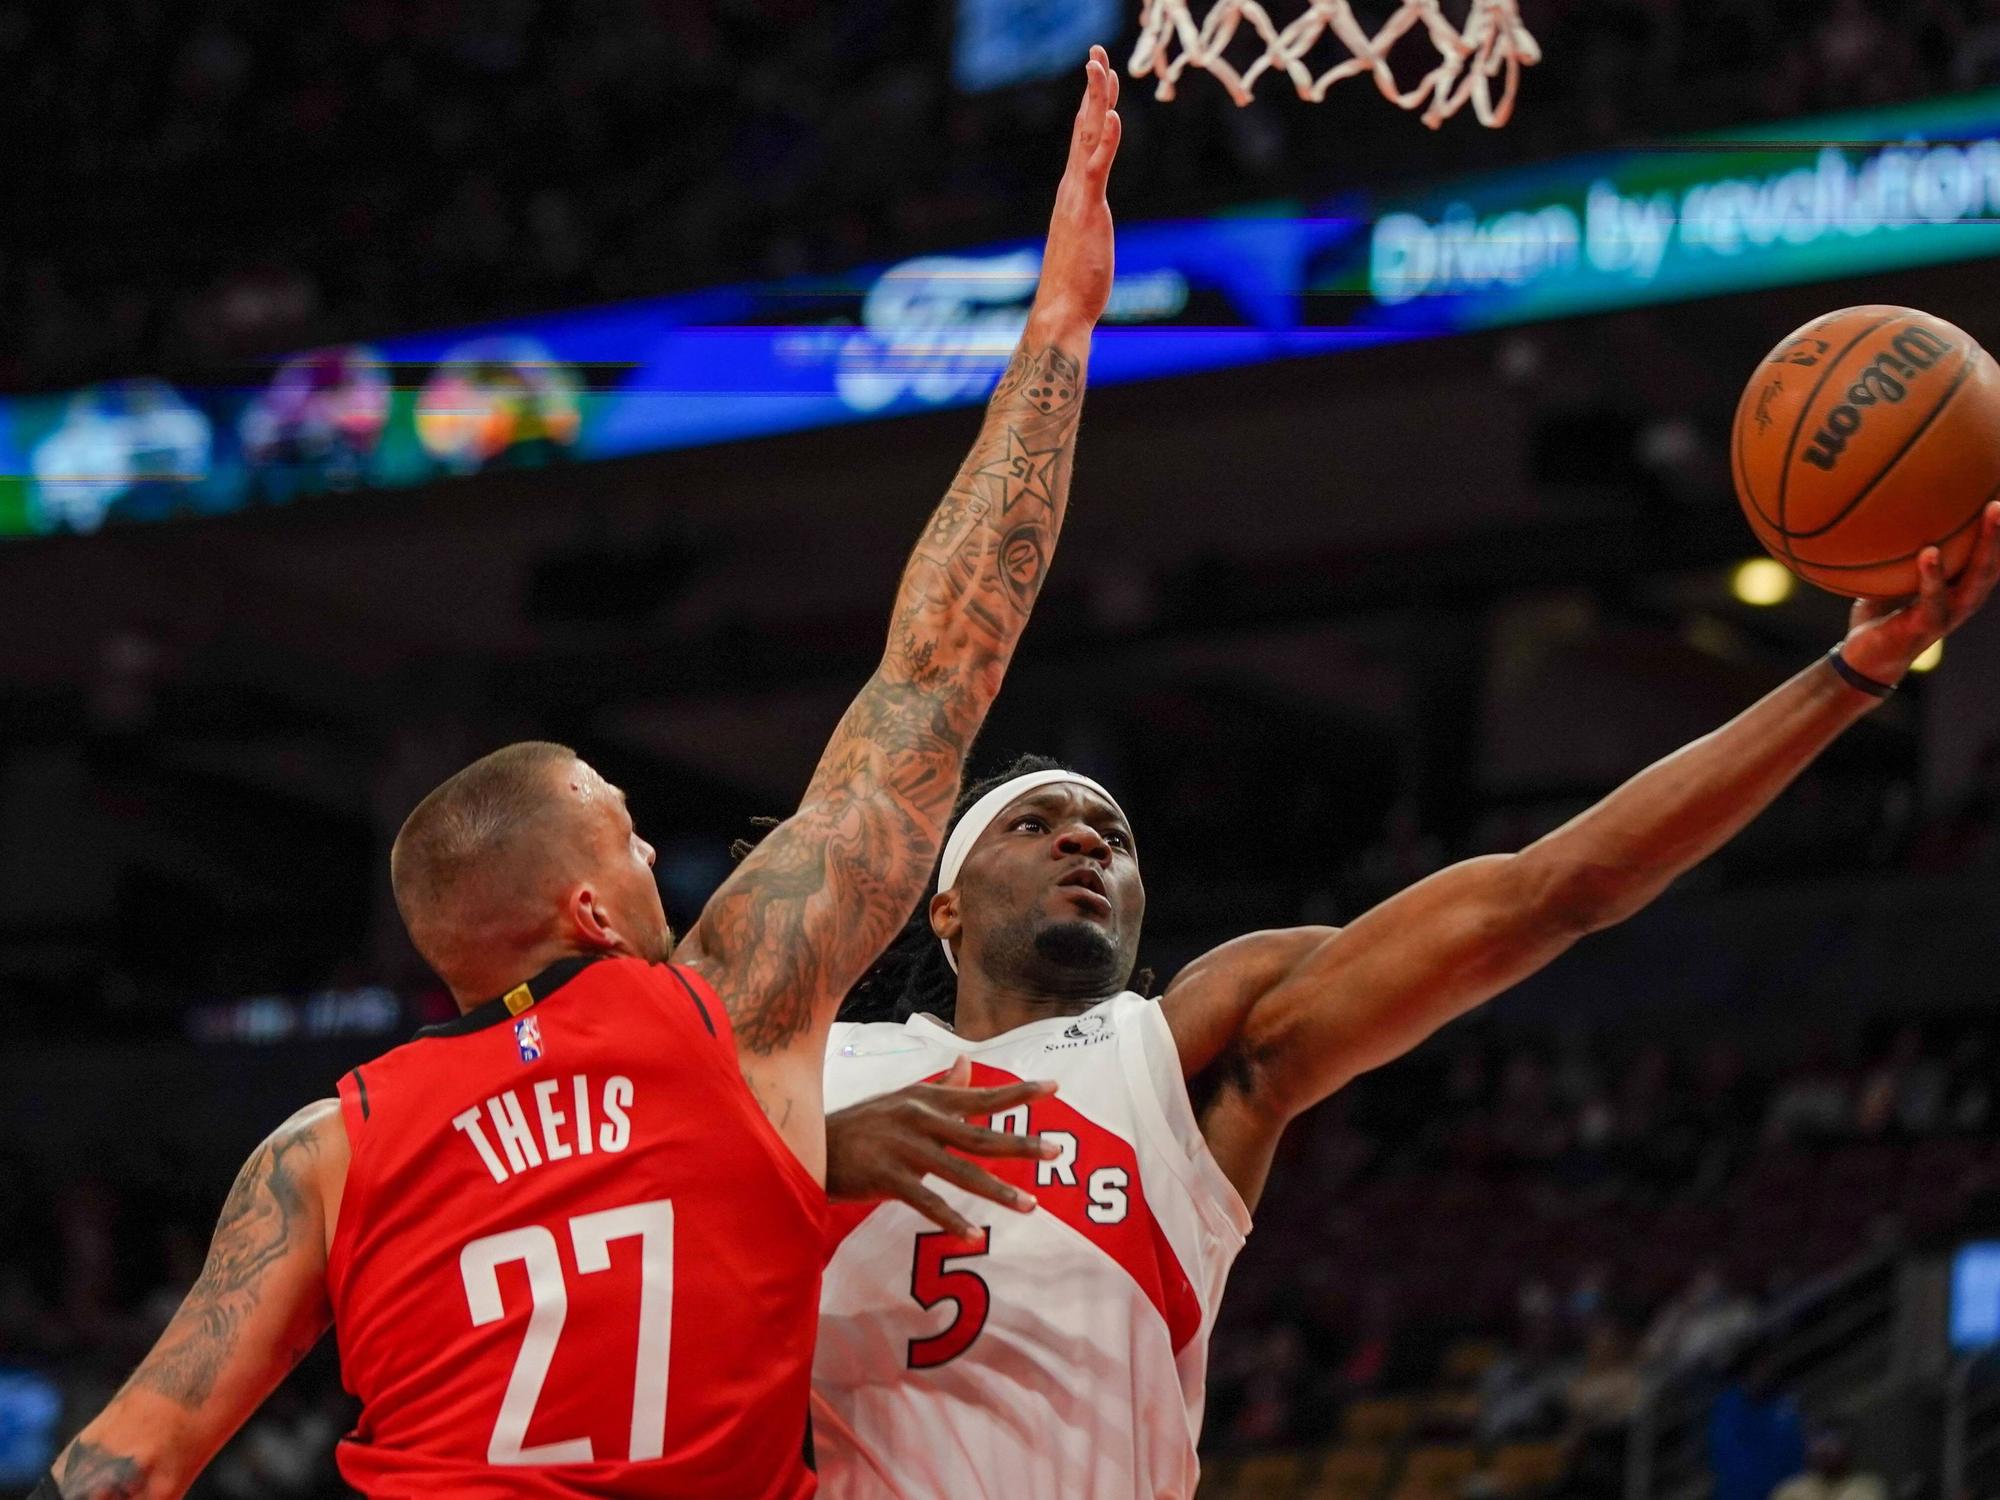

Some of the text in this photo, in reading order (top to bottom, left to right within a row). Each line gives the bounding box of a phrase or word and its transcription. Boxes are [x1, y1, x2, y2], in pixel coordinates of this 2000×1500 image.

[1371, 203, 1580, 304] Driven
[1587, 178, 1675, 284] by
[1803, 326, 1951, 471] Wilson
[1009, 456, 1036, 484] 15
[1043, 1031, 1114, 1054] Sun Life
[453, 1074, 634, 1184] THEIS
[460, 1199, 674, 1466] 27
[907, 1226, 991, 1370] 5
